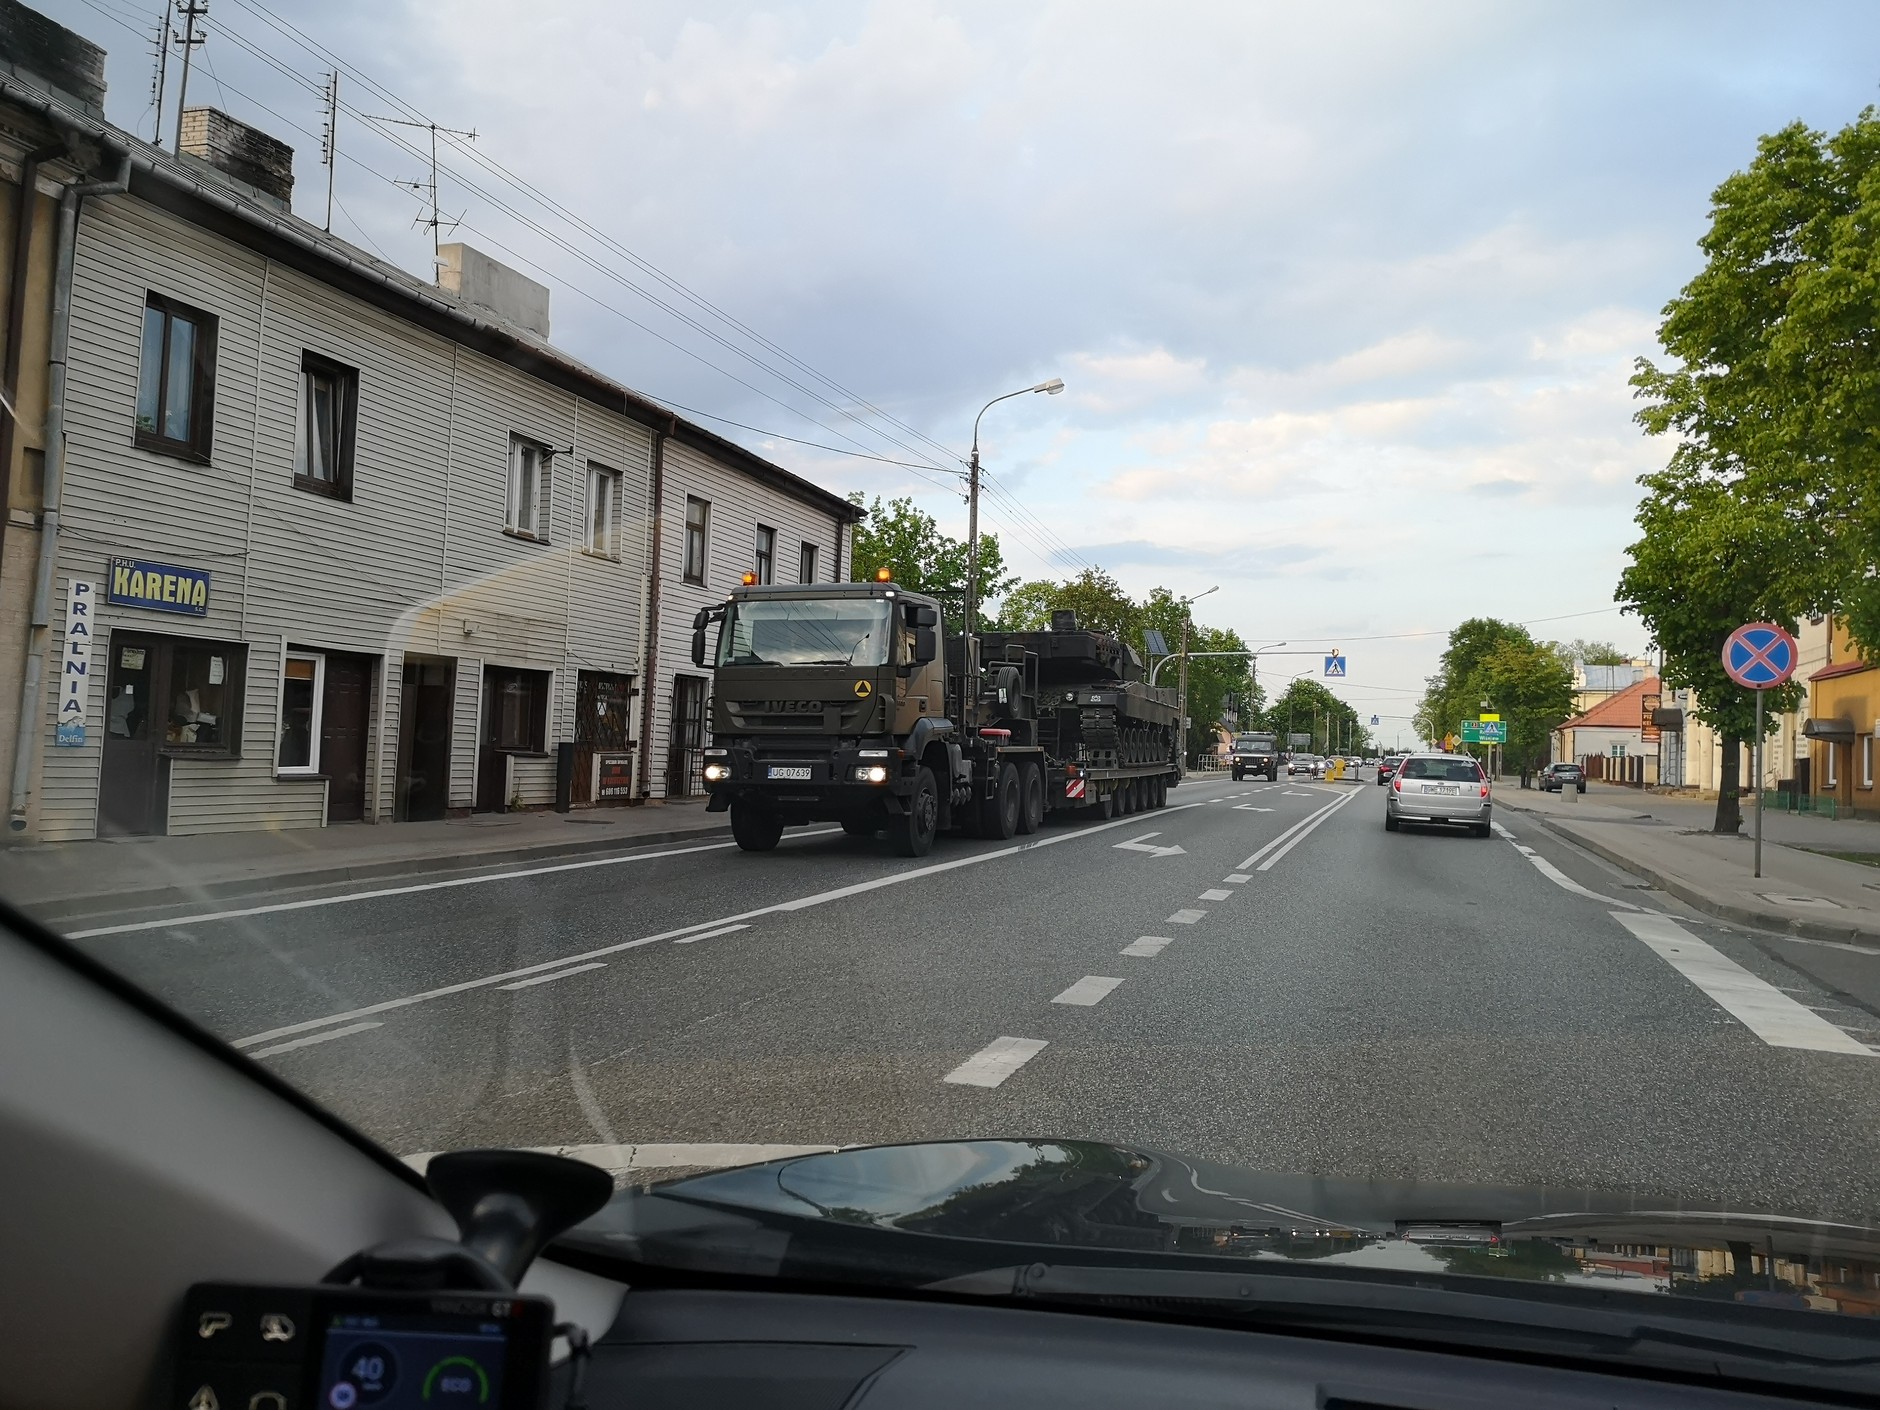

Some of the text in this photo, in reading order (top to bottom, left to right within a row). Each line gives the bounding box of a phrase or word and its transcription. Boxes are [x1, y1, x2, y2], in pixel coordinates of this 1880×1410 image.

[115, 559, 136, 569] P.H.U.
[113, 567, 206, 607] KARENA
[62, 582, 90, 713] PRALNIA
[764, 700, 823, 713] IVECO
[58, 734, 83, 743] Delfin
[772, 768, 811, 777] UG 07639
[352, 1355, 385, 1381] 40
